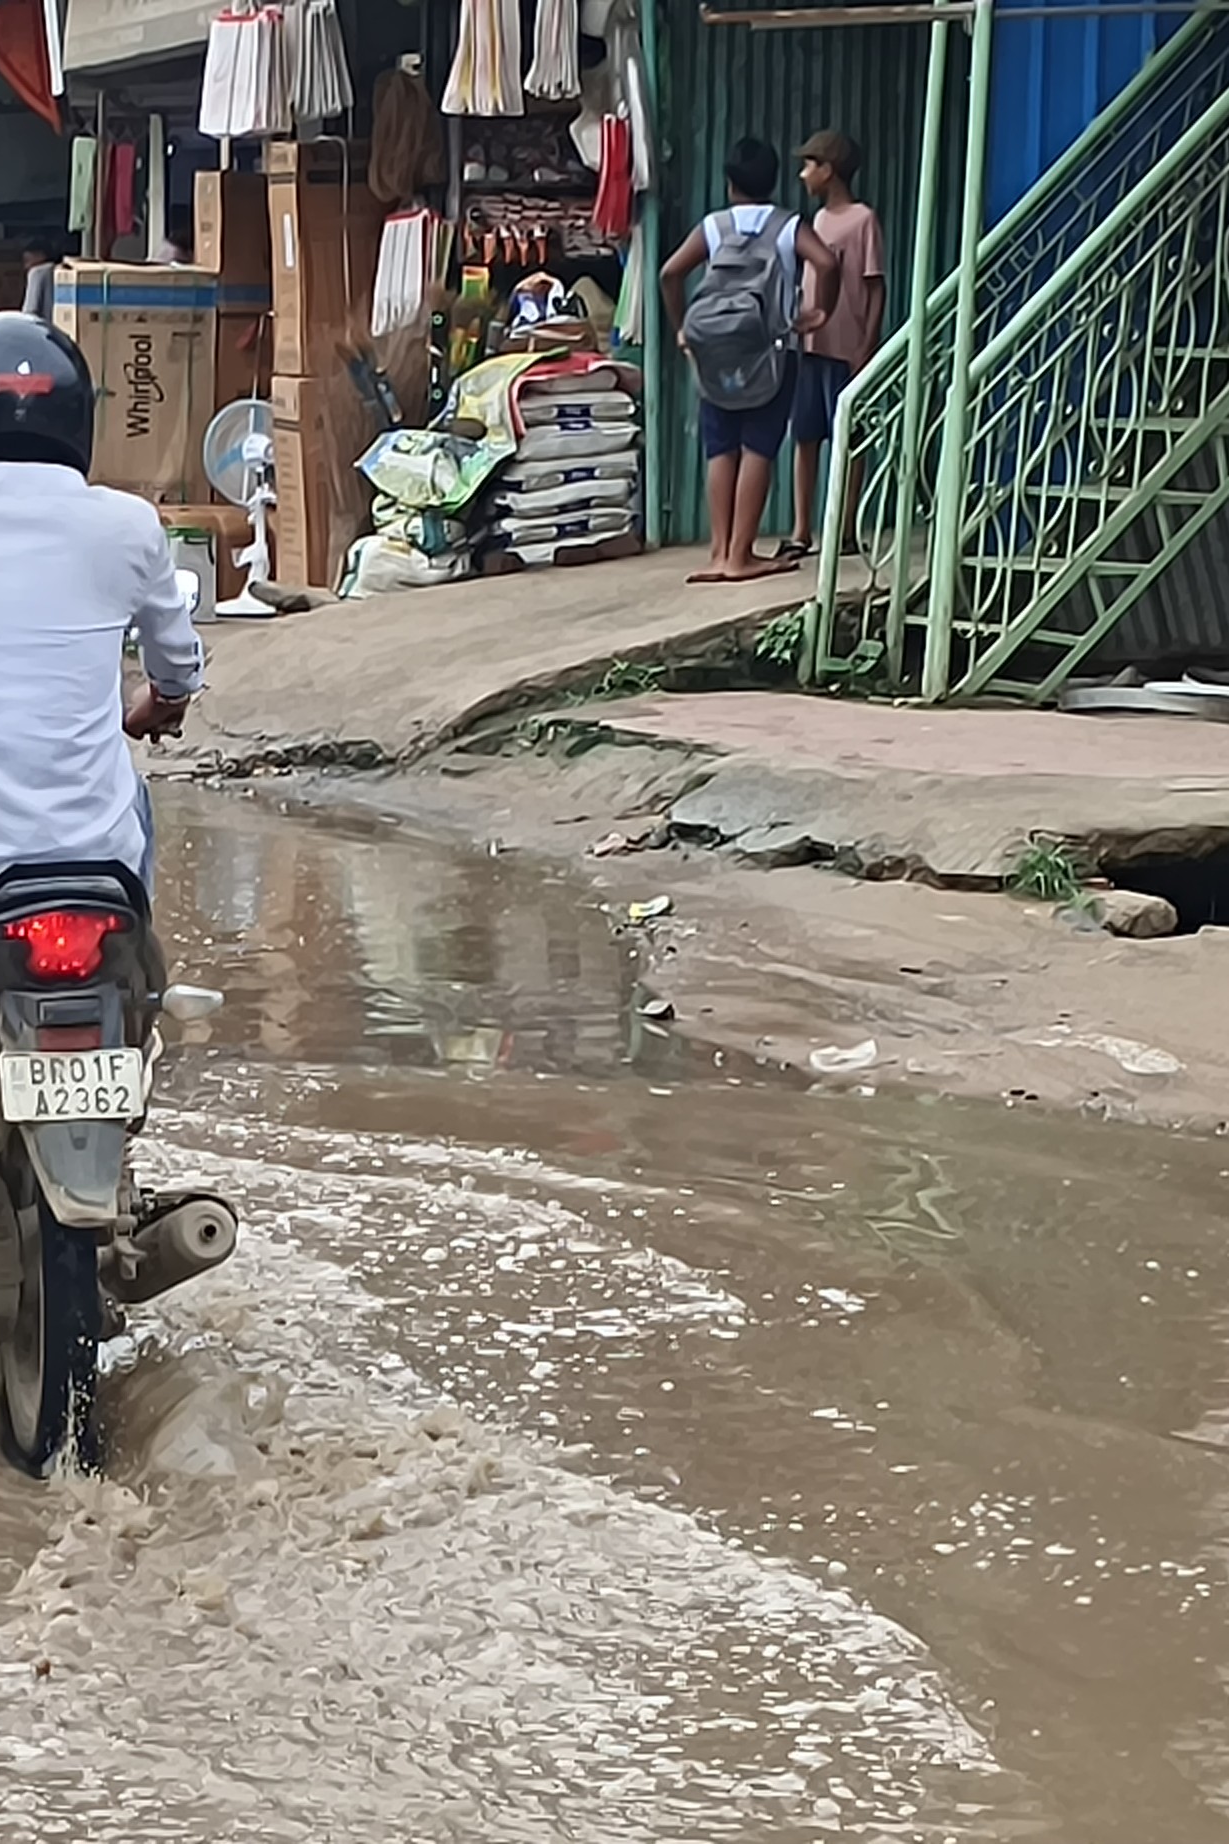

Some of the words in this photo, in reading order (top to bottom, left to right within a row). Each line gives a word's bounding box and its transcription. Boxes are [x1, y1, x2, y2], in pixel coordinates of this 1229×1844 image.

[123, 334, 165, 438] Whirlpool
[30, 1055, 124, 1085] BR01F
[35, 1086, 130, 1117] A2362
